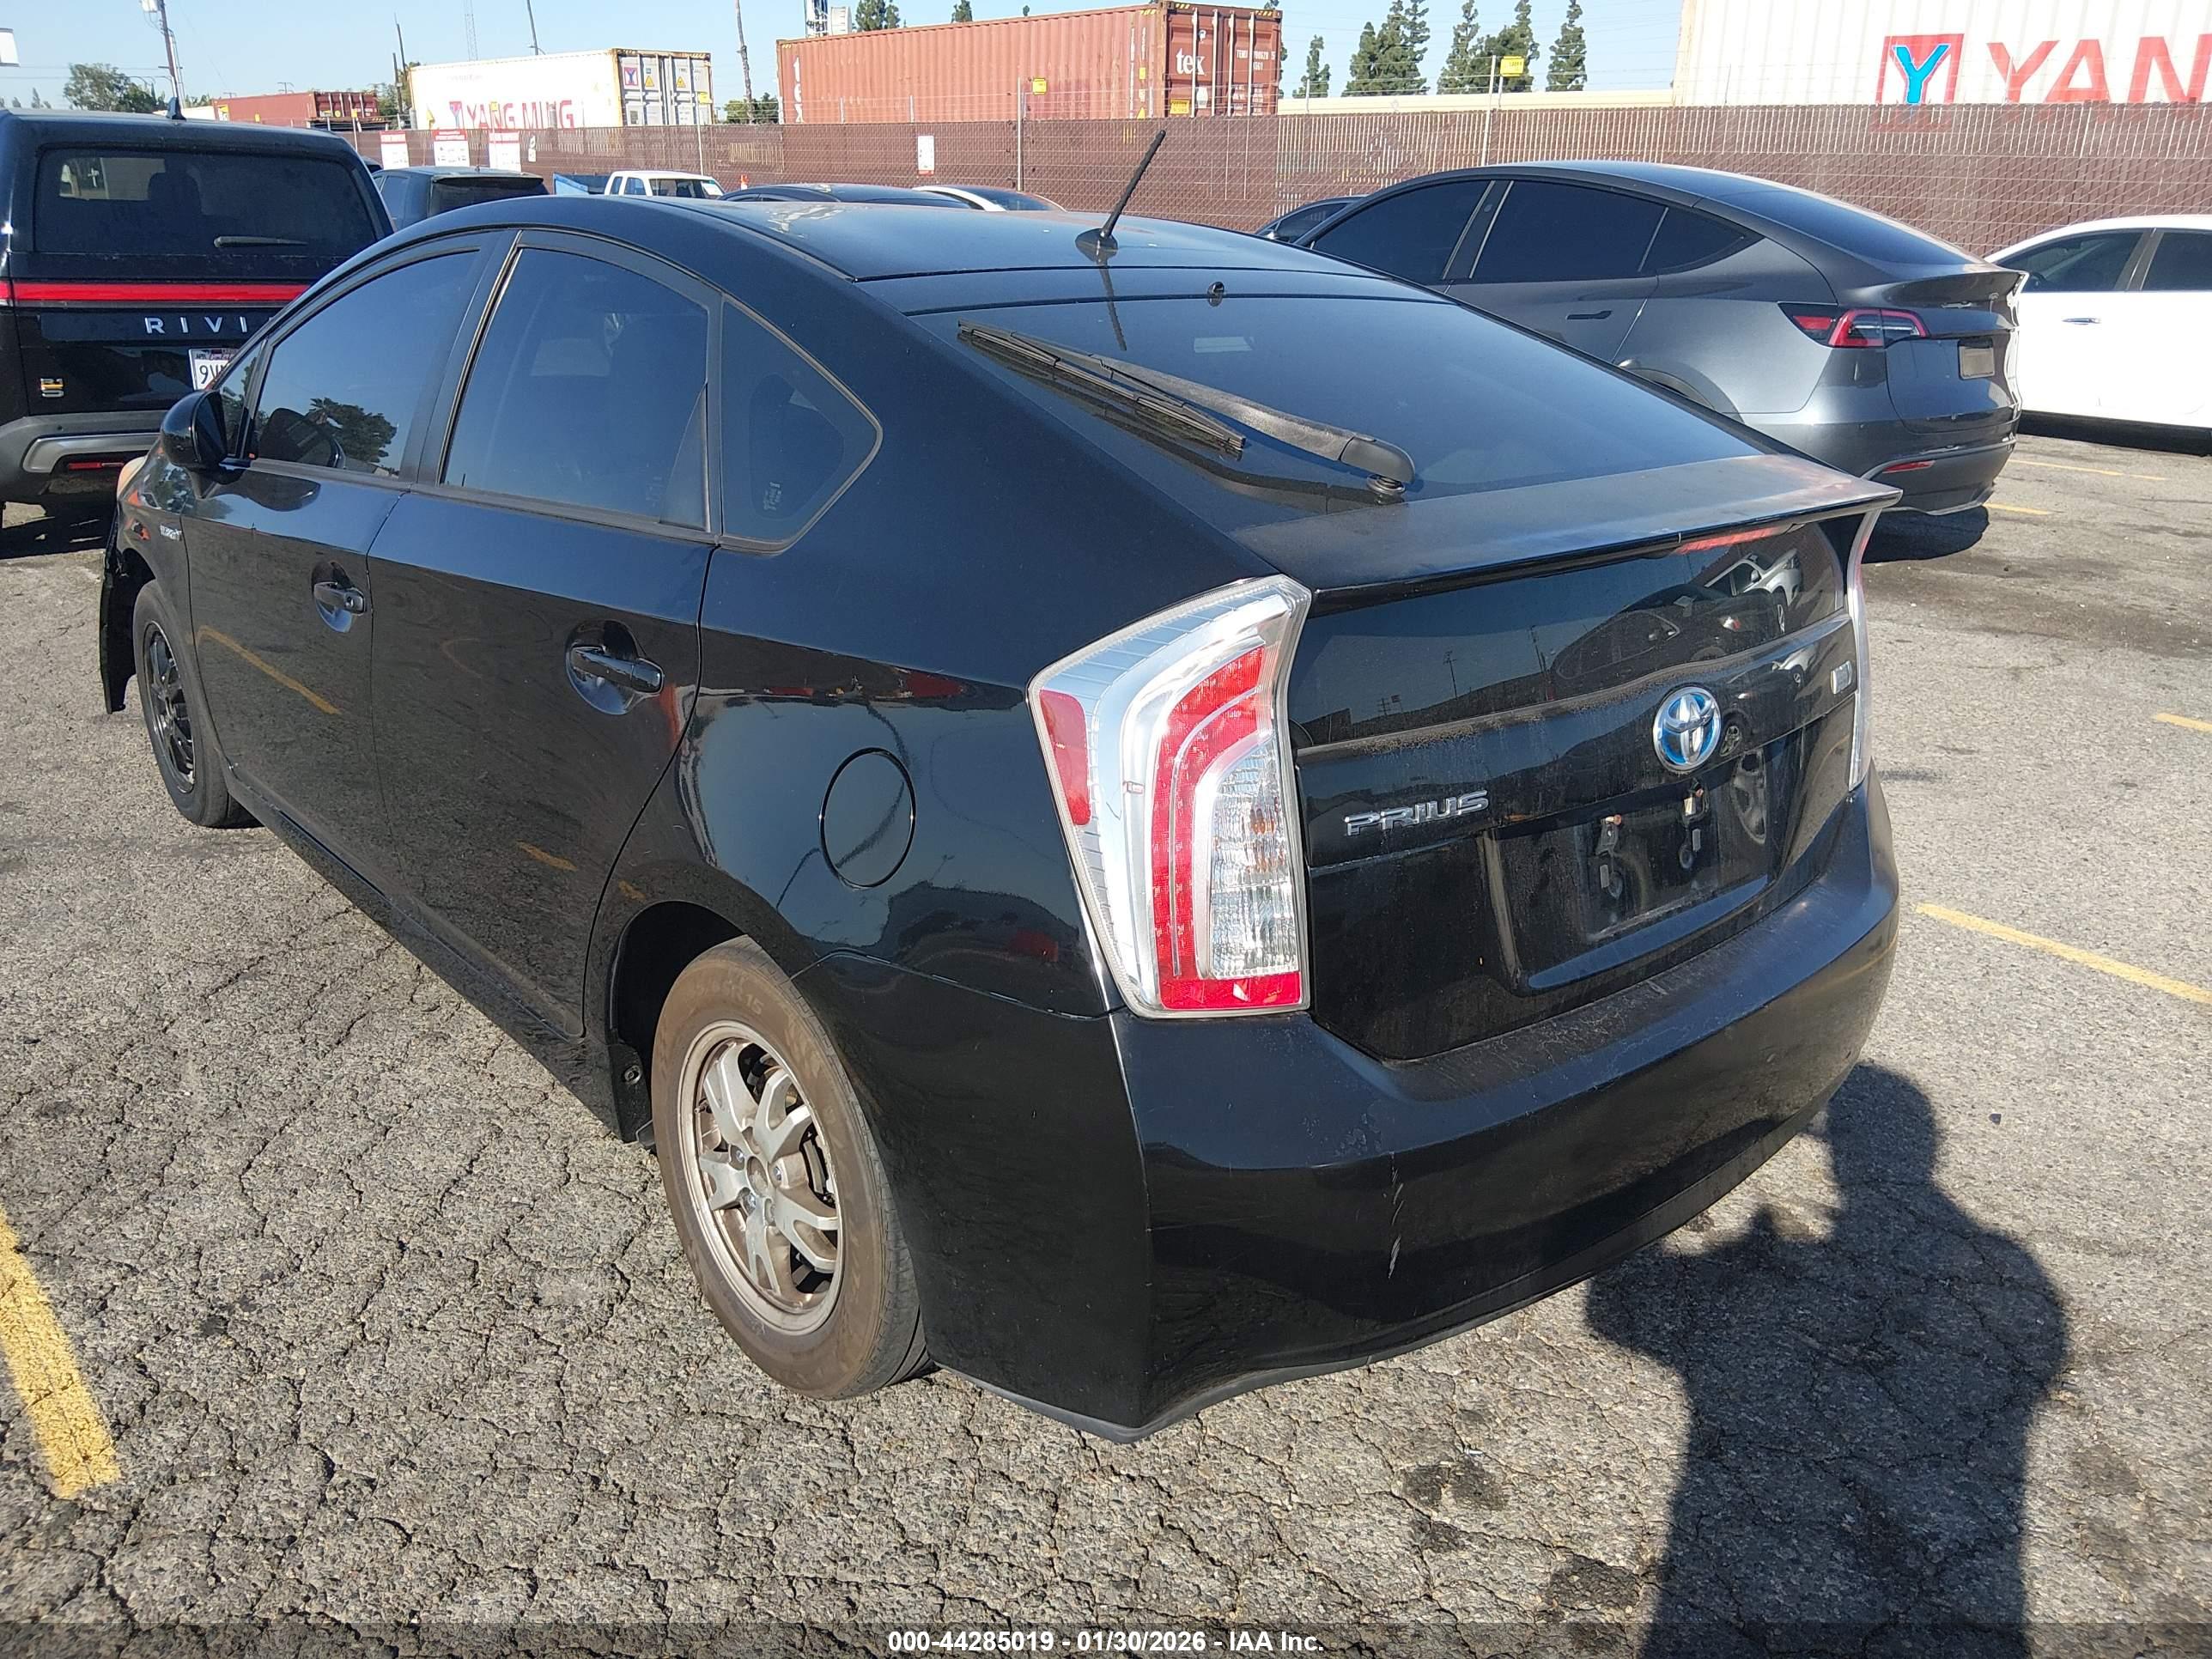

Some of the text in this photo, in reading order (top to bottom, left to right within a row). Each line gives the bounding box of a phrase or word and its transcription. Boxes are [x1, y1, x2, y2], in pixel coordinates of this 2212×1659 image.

[467, 102, 515, 129] YANG
[145, 317, 273, 333] RIVI
[1344, 789, 1490, 836] PRIUS
